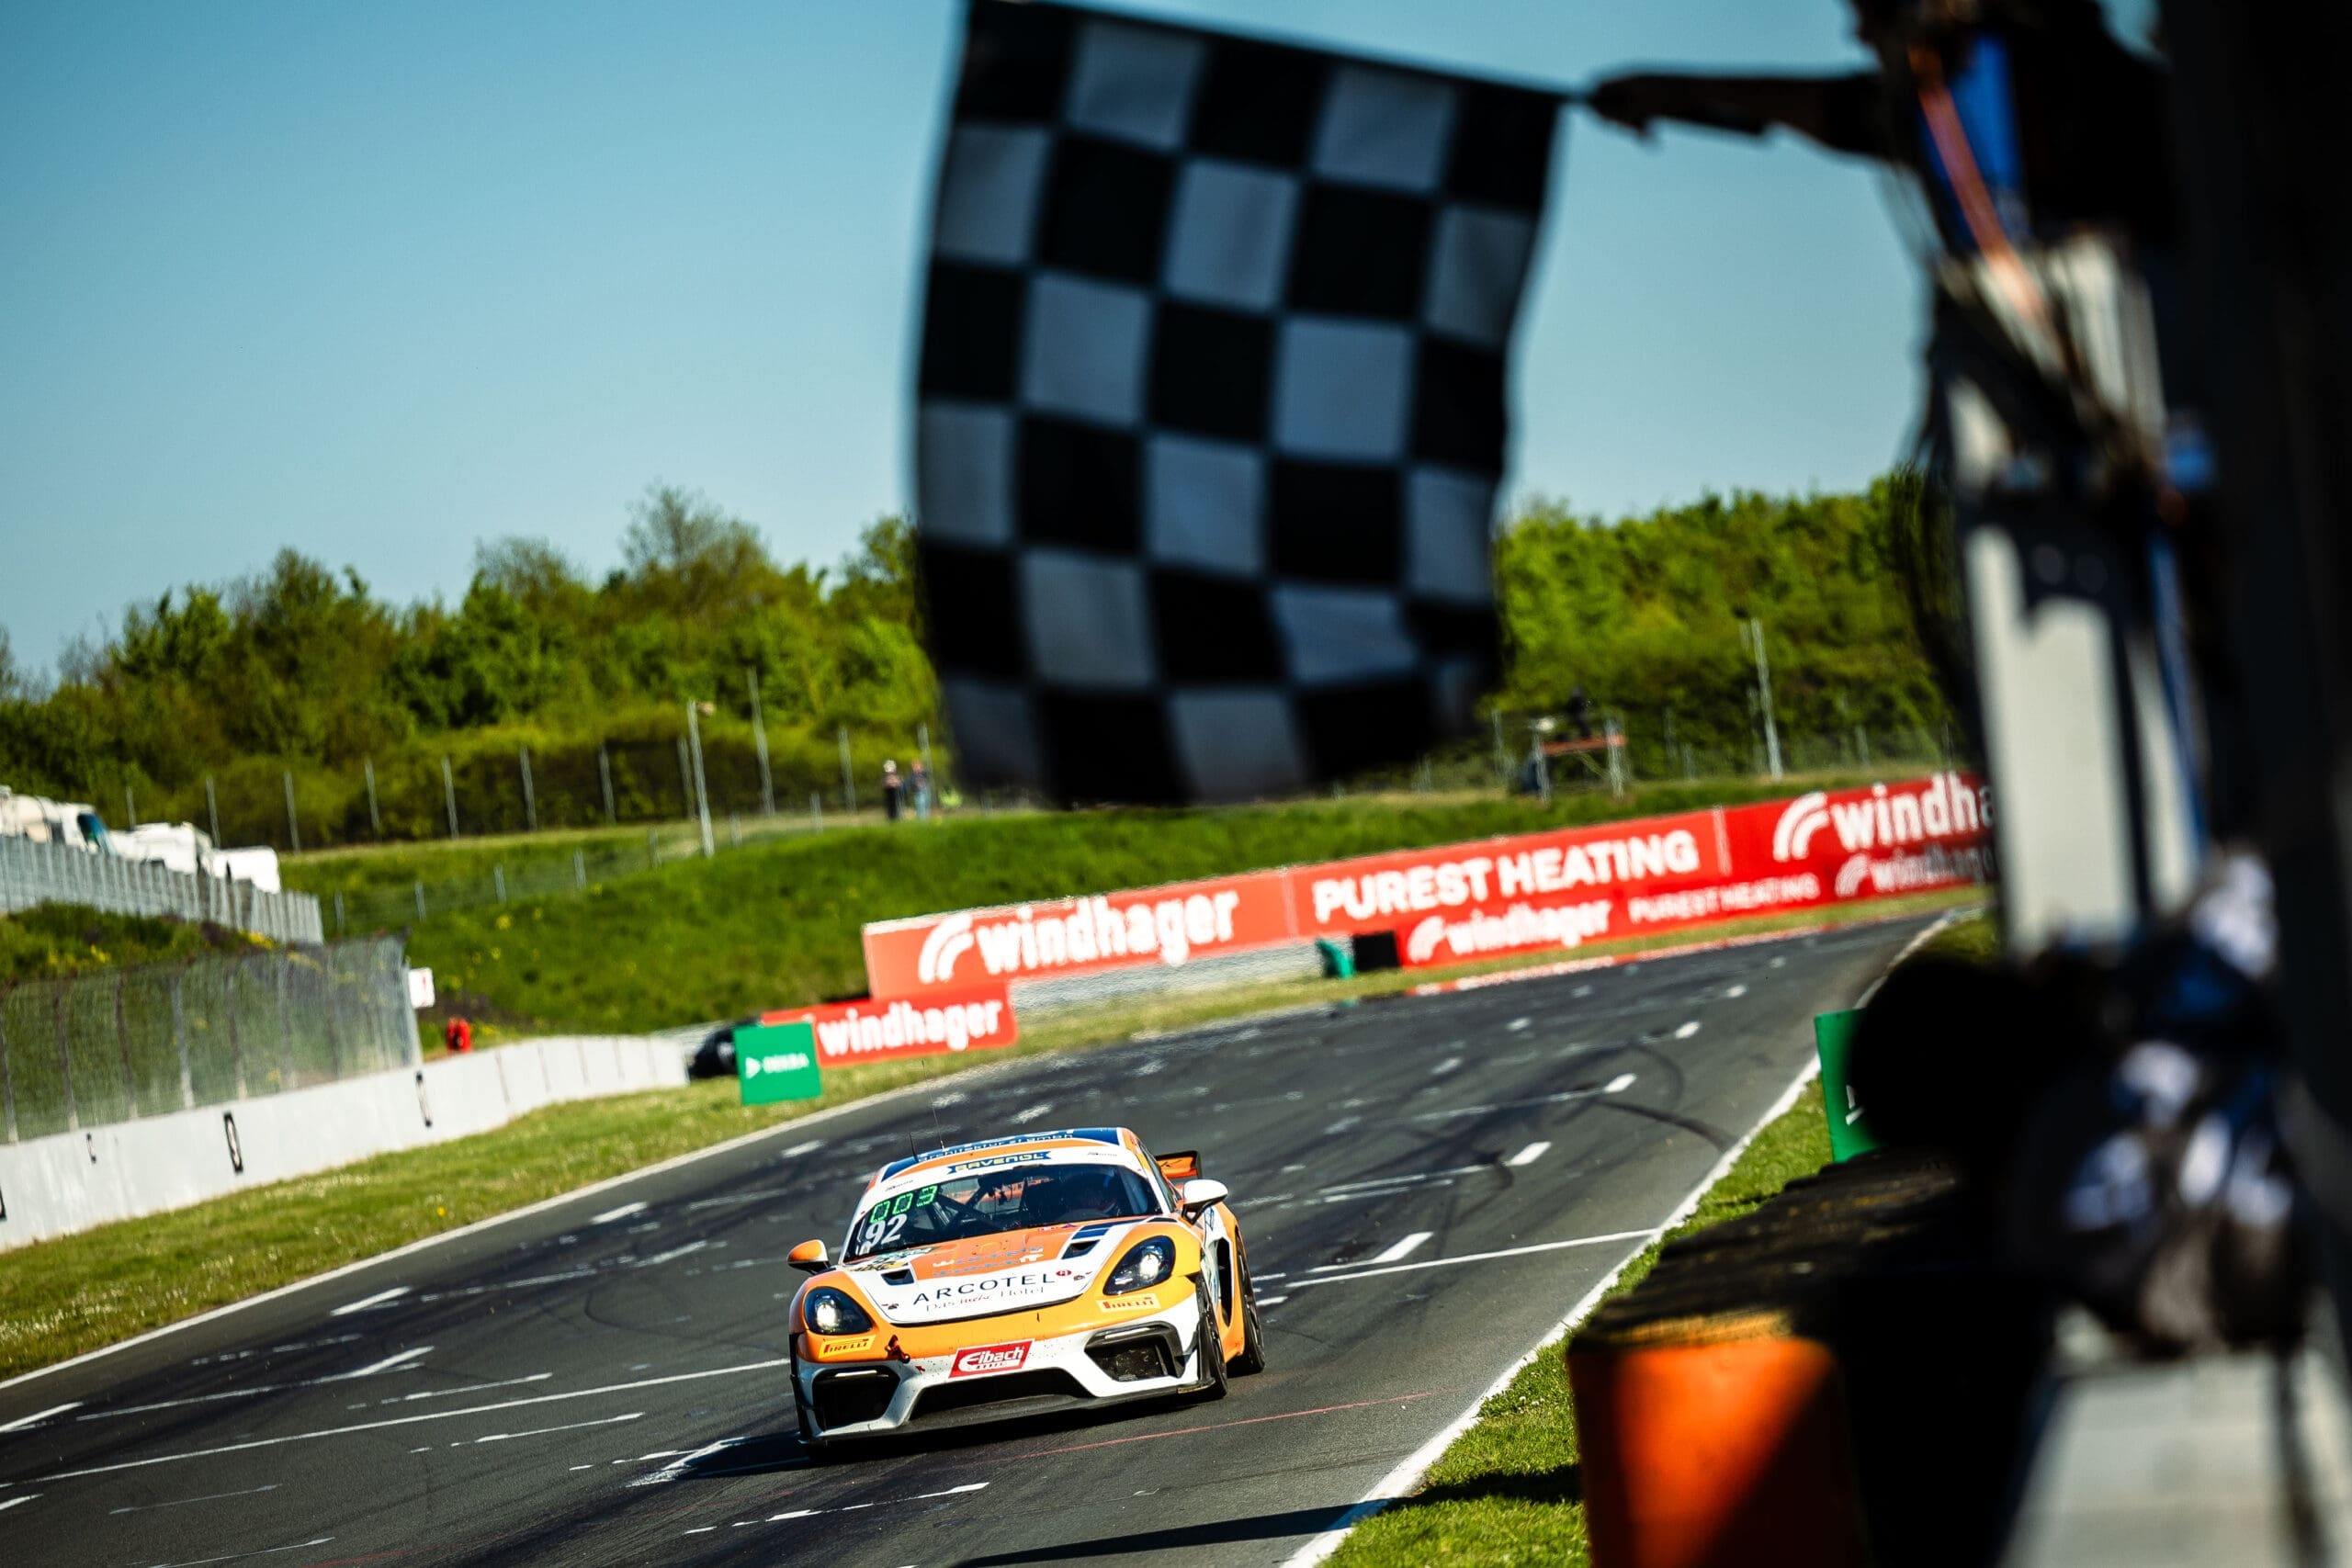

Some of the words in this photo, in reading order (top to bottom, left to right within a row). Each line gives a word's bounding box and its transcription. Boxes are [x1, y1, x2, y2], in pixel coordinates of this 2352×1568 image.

[1313, 857, 1492, 923] PUREST
[1497, 829, 1699, 896] HEATING
[1628, 886, 1719, 924] PUREST
[1721, 873, 1820, 911] HEATING
[976, 894, 1238, 964] windhager
[1445, 899, 1611, 947] windhager
[818, 1000, 1002, 1050] windhager
[956, 1153, 1043, 1172] RAVENOL
[865, 1213, 907, 1247] 92
[913, 1273, 1055, 1304] ARCOTEL
[1102, 1296, 1155, 1309] PIRELLI
[823, 1337, 870, 1354] PIRELLI
[958, 1346, 1023, 1372] Eibach
